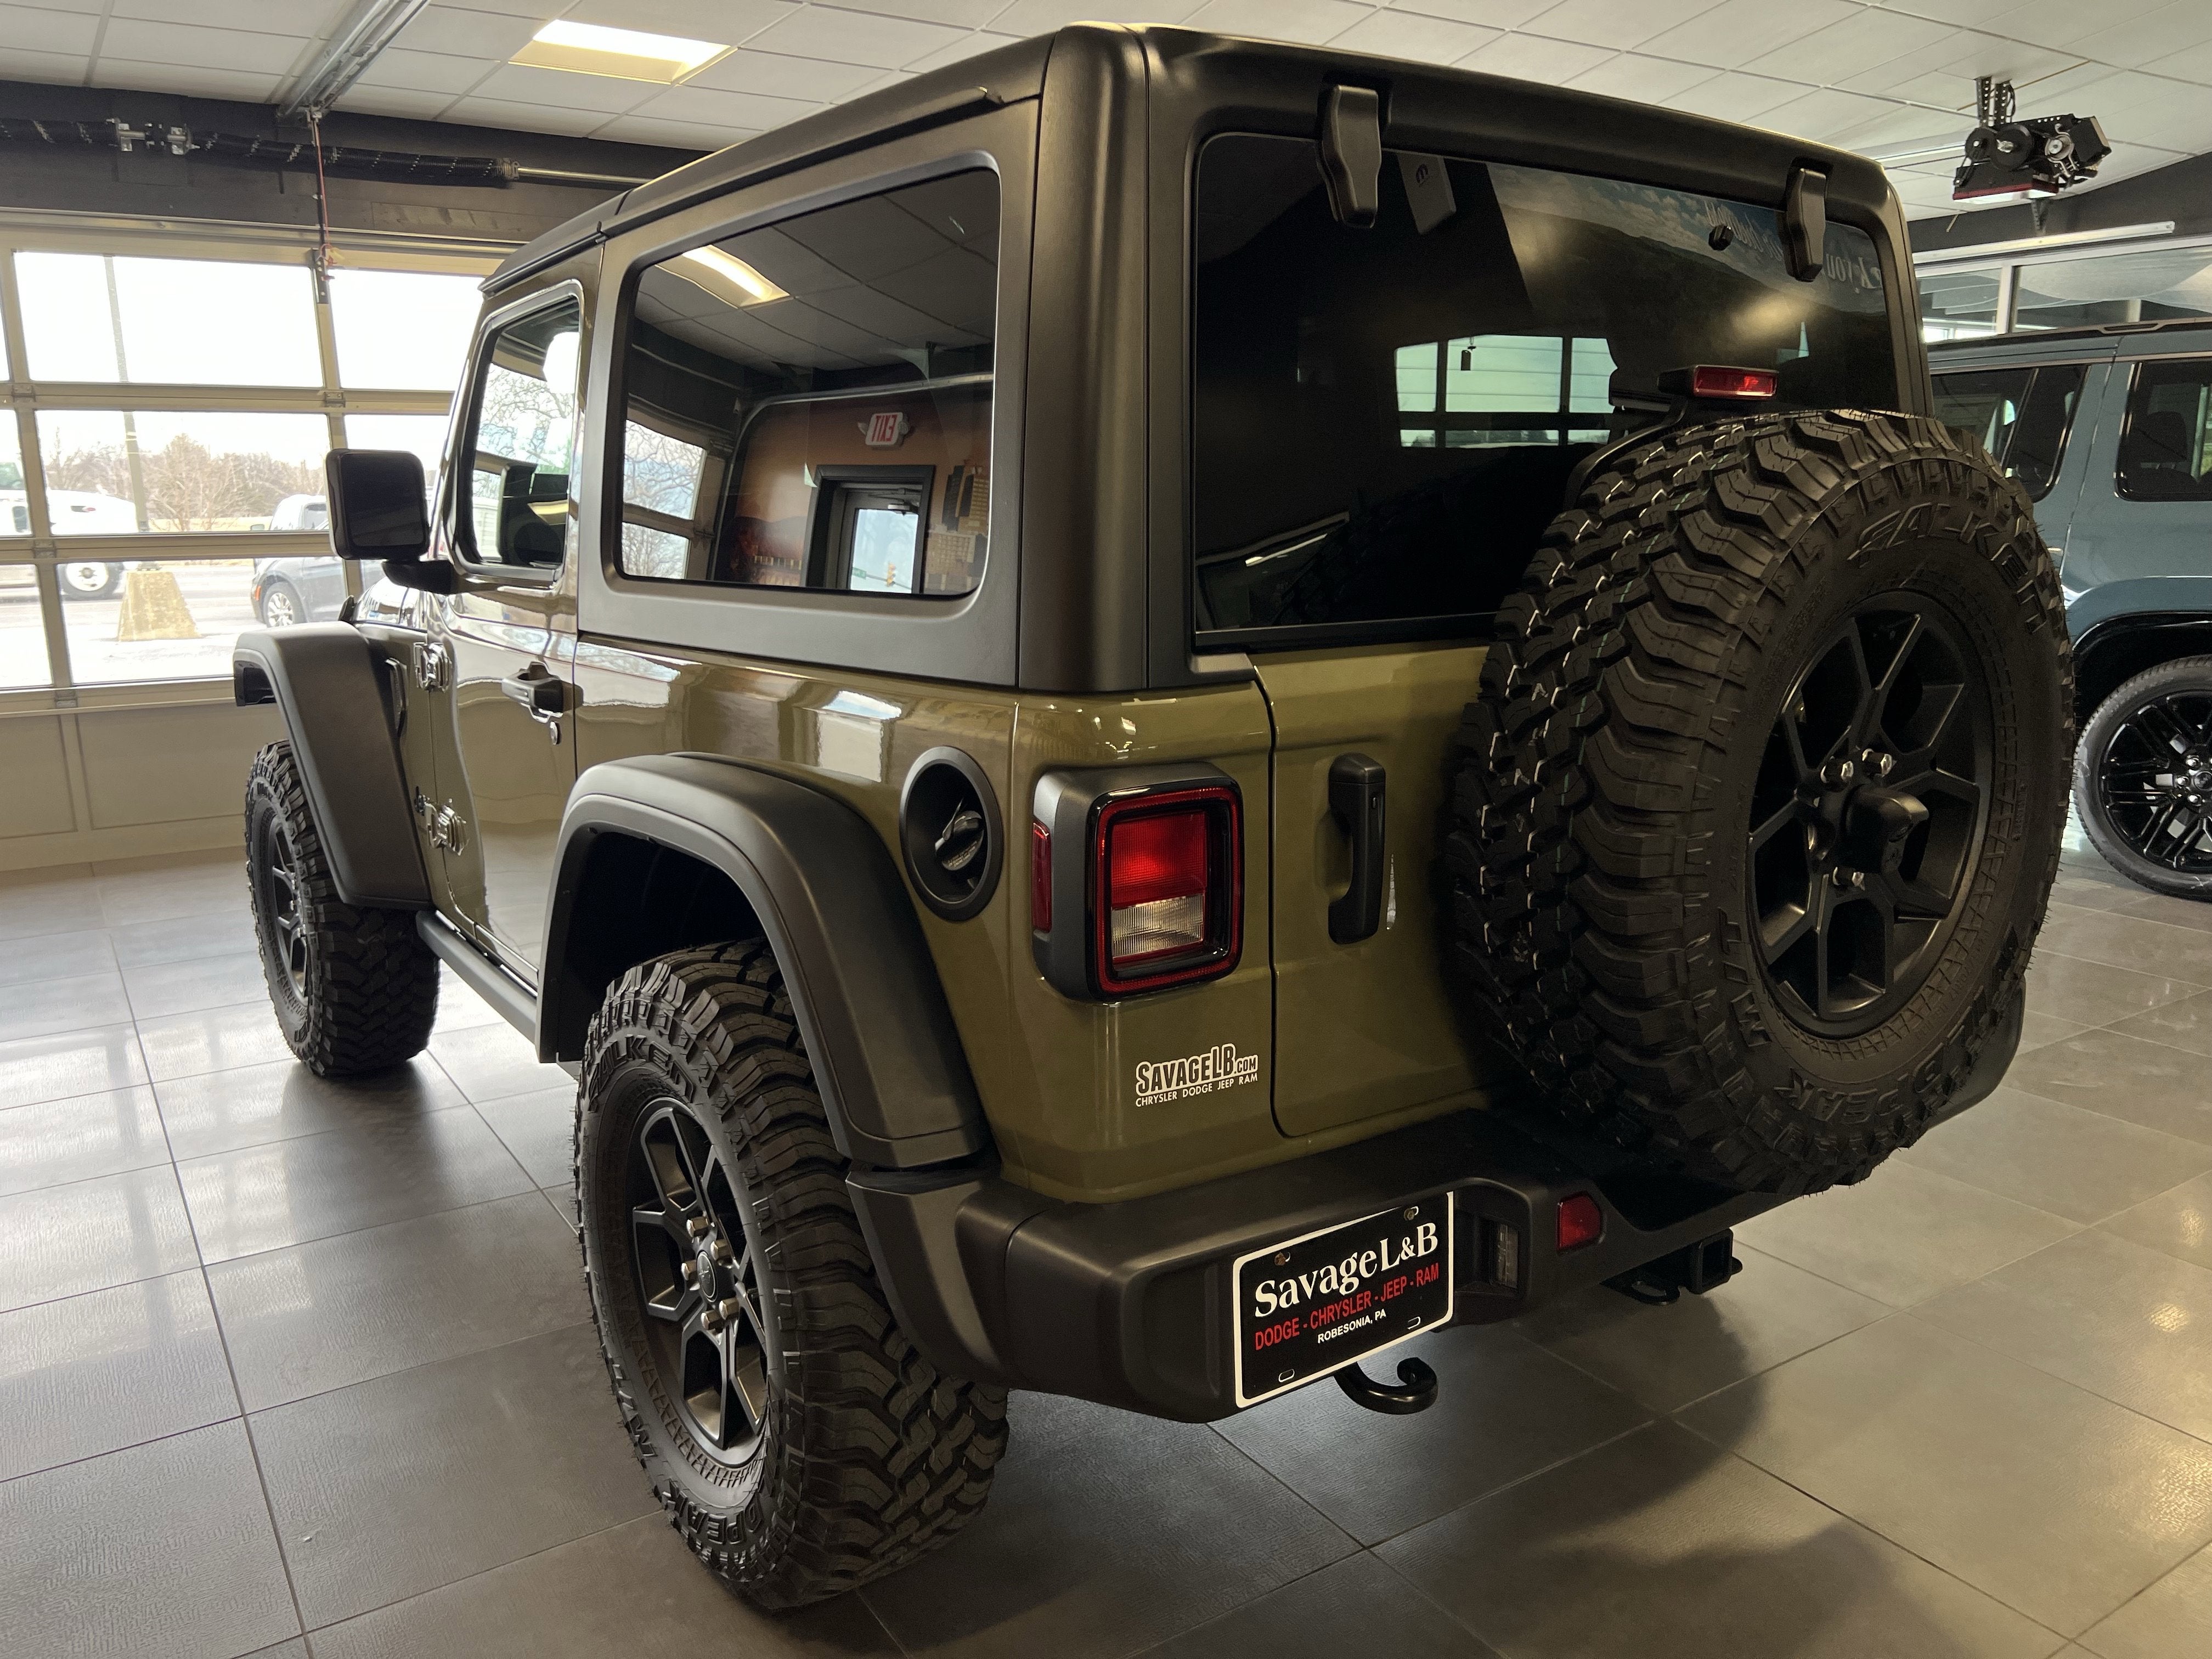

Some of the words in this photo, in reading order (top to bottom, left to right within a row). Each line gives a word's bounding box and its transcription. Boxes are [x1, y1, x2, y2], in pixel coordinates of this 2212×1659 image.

[1136, 1091, 1177, 1107] CHRYSLER
[1182, 1083, 1212, 1098] DODGE
[1217, 1079, 1234, 1090] JEEP
[1239, 1073, 1258, 1085] RAM
[1255, 1318, 1299, 1350] DODGE
[1310, 1291, 1372, 1329] CHRYSLER
[1380, 1276, 1407, 1302] JEEP
[1417, 1263, 1438, 1288] RAM
[1375, 1308, 1387, 1321] PA
